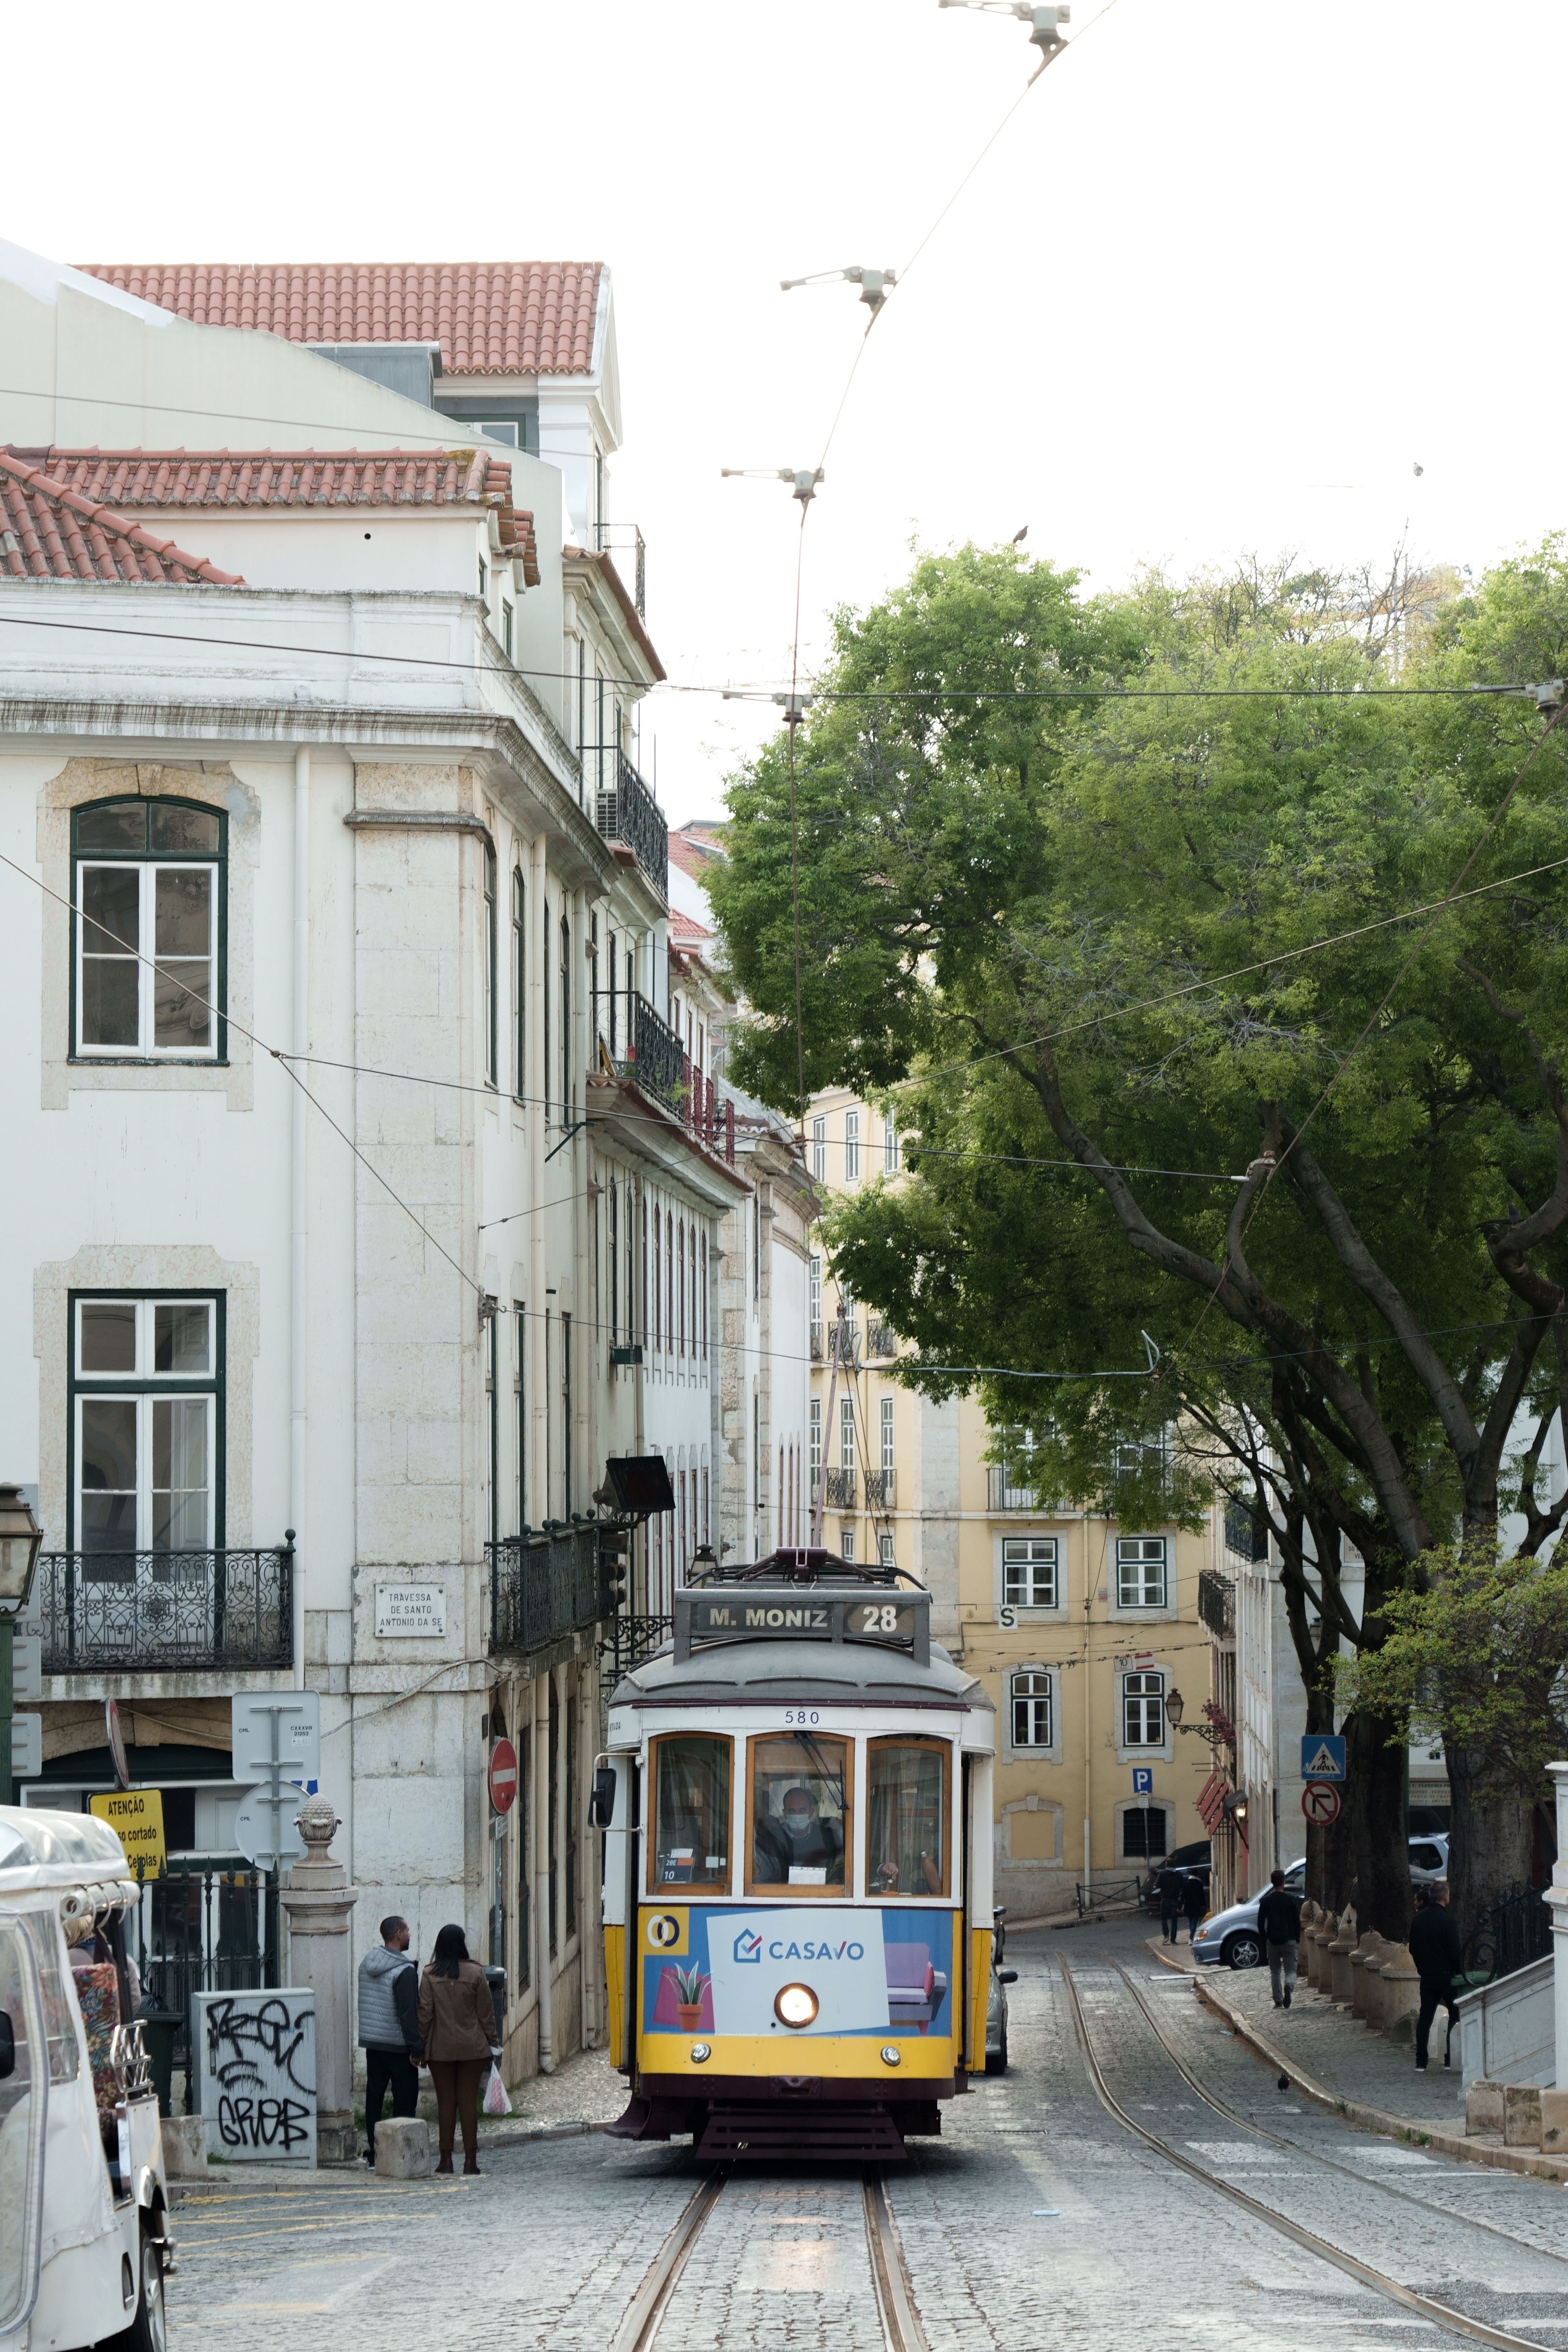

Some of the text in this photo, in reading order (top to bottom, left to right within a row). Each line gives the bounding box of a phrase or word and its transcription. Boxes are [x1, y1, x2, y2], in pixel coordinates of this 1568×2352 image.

[389, 1593, 431, 1601] TRAVESSA
[418, 1618, 428, 1626] DA
[432, 1616, 442, 1626] SÉ
[710, 1608, 828, 1627] M. MONIZ
[863, 1606, 897, 1632] 28
[1001, 1607, 1014, 1627] S
[1119, 1658, 1127, 1666] 10
[785, 1711, 819, 1724] 580
[1137, 1771, 1148, 1790] P
[108, 1796, 144, 1818] ATENÇÃO
[128, 1825, 157, 1842] cortado
[664, 1871, 675, 1880] 10
[769, 1941, 864, 1960] CASAVO
